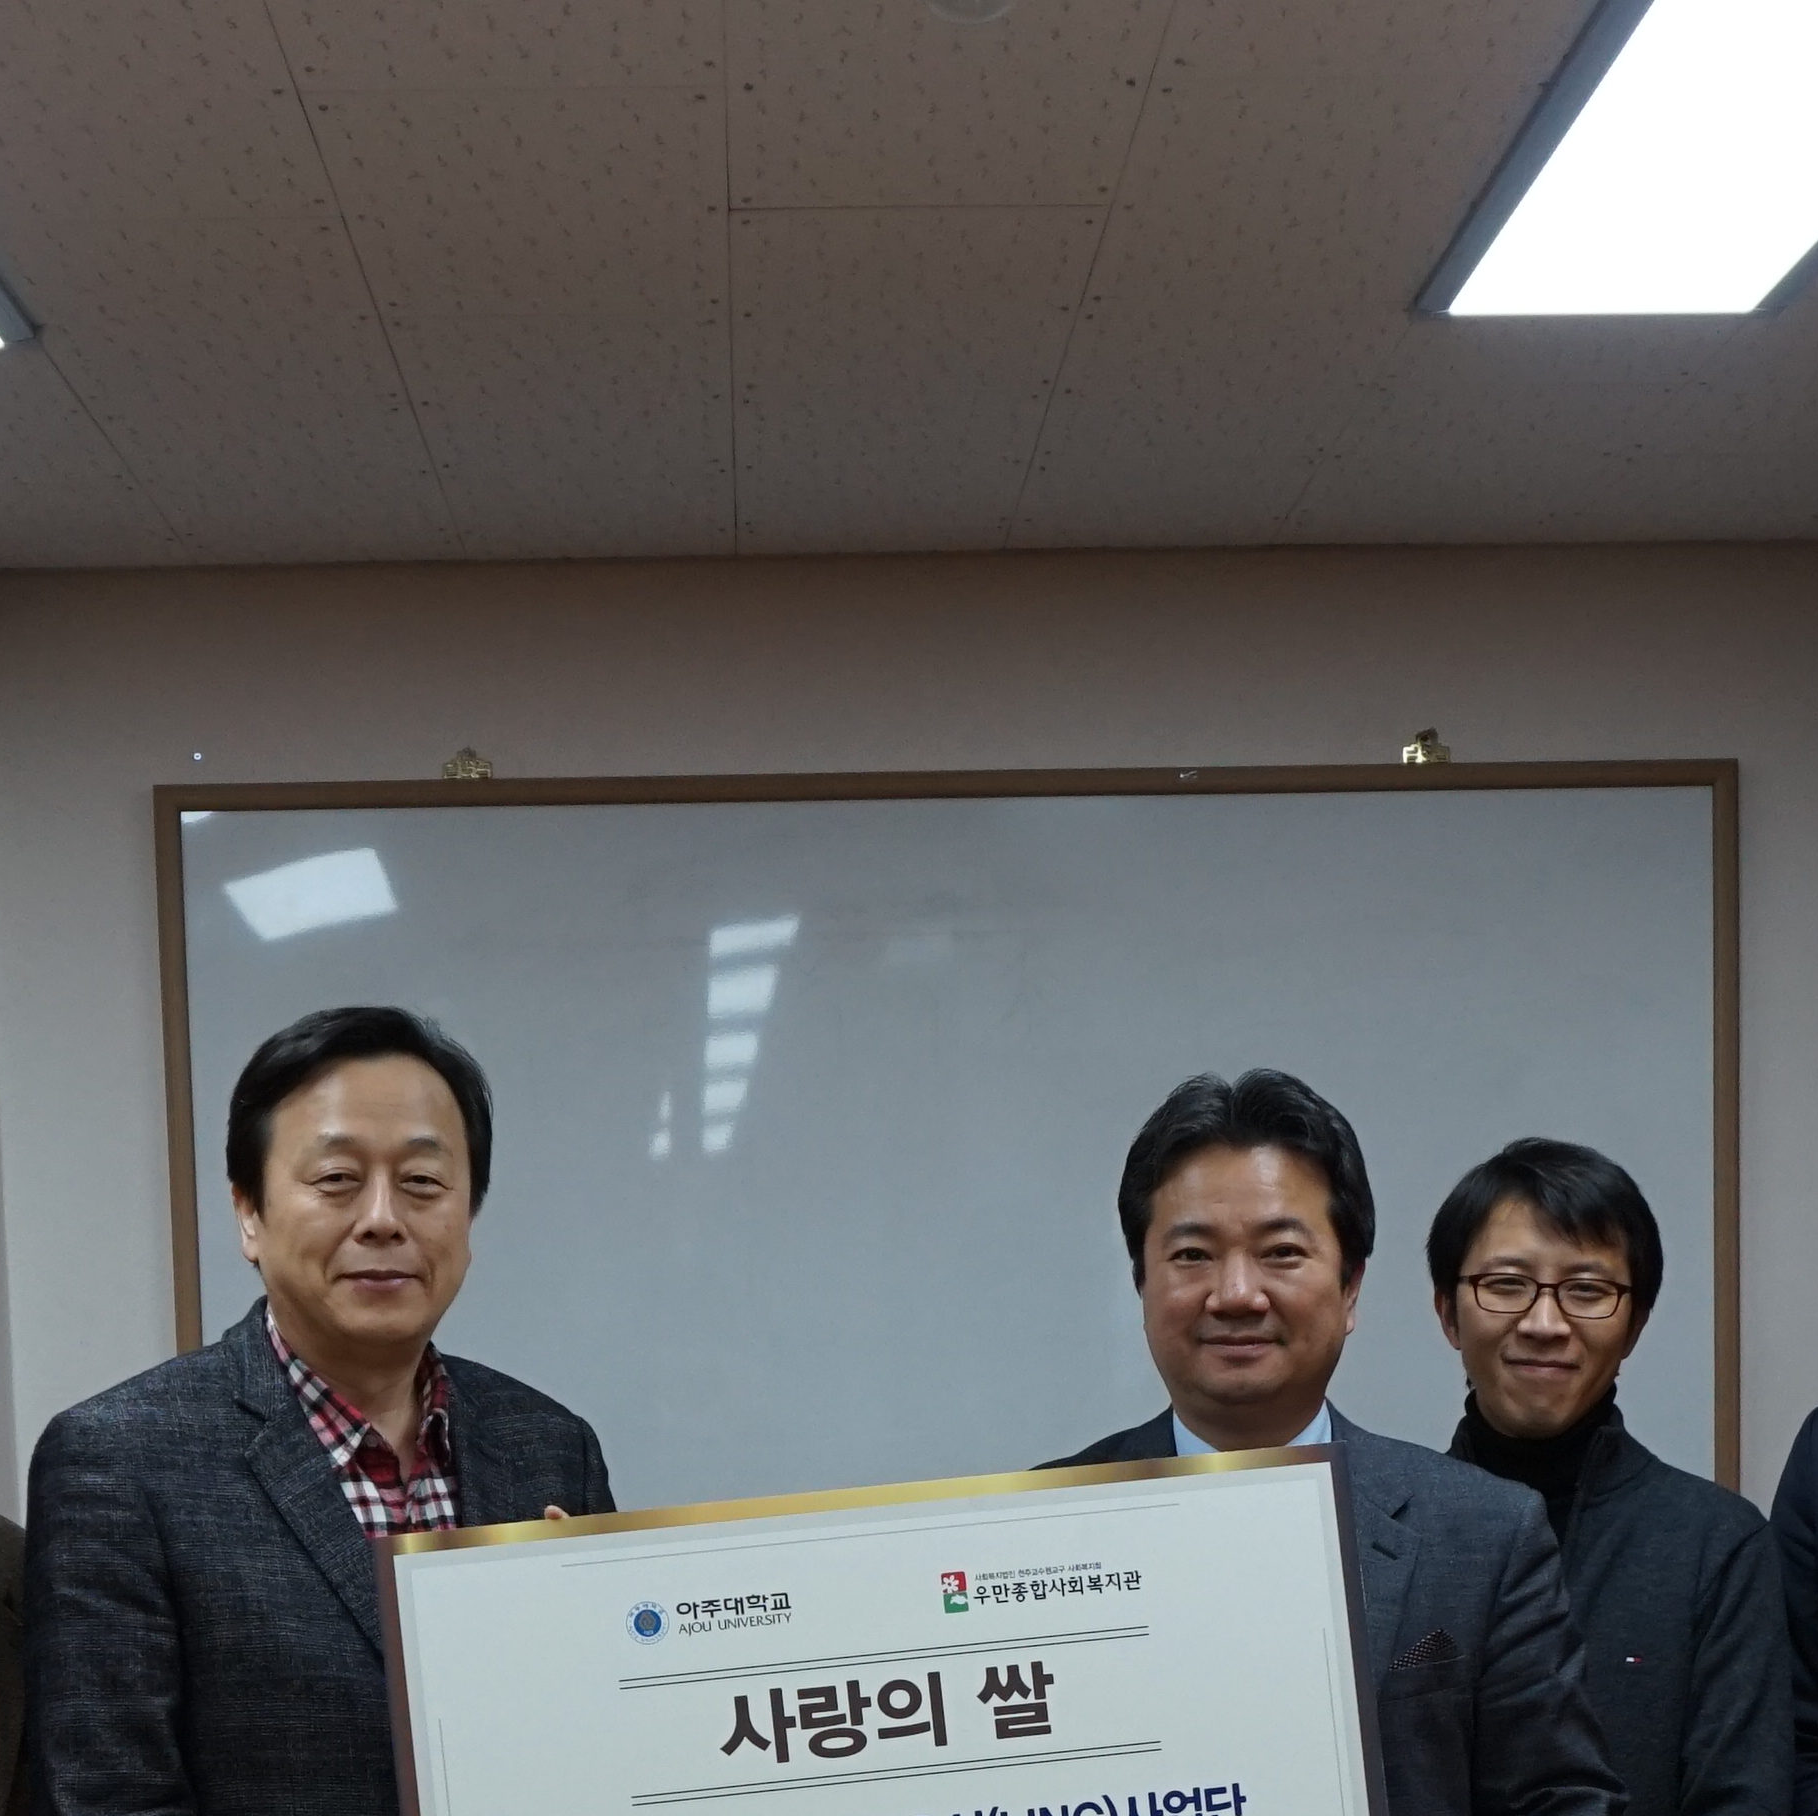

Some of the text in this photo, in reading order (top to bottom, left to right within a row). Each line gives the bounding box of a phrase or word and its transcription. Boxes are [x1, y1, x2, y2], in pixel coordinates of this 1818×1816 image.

[973, 1570, 1142, 1605] 우만종합사회복지관
[676, 1592, 791, 1619] 아주대학교
[679, 1613, 792, 1636] AJOU UNIVERSITY
[720, 1661, 1055, 1764] 사랑의 쌀
